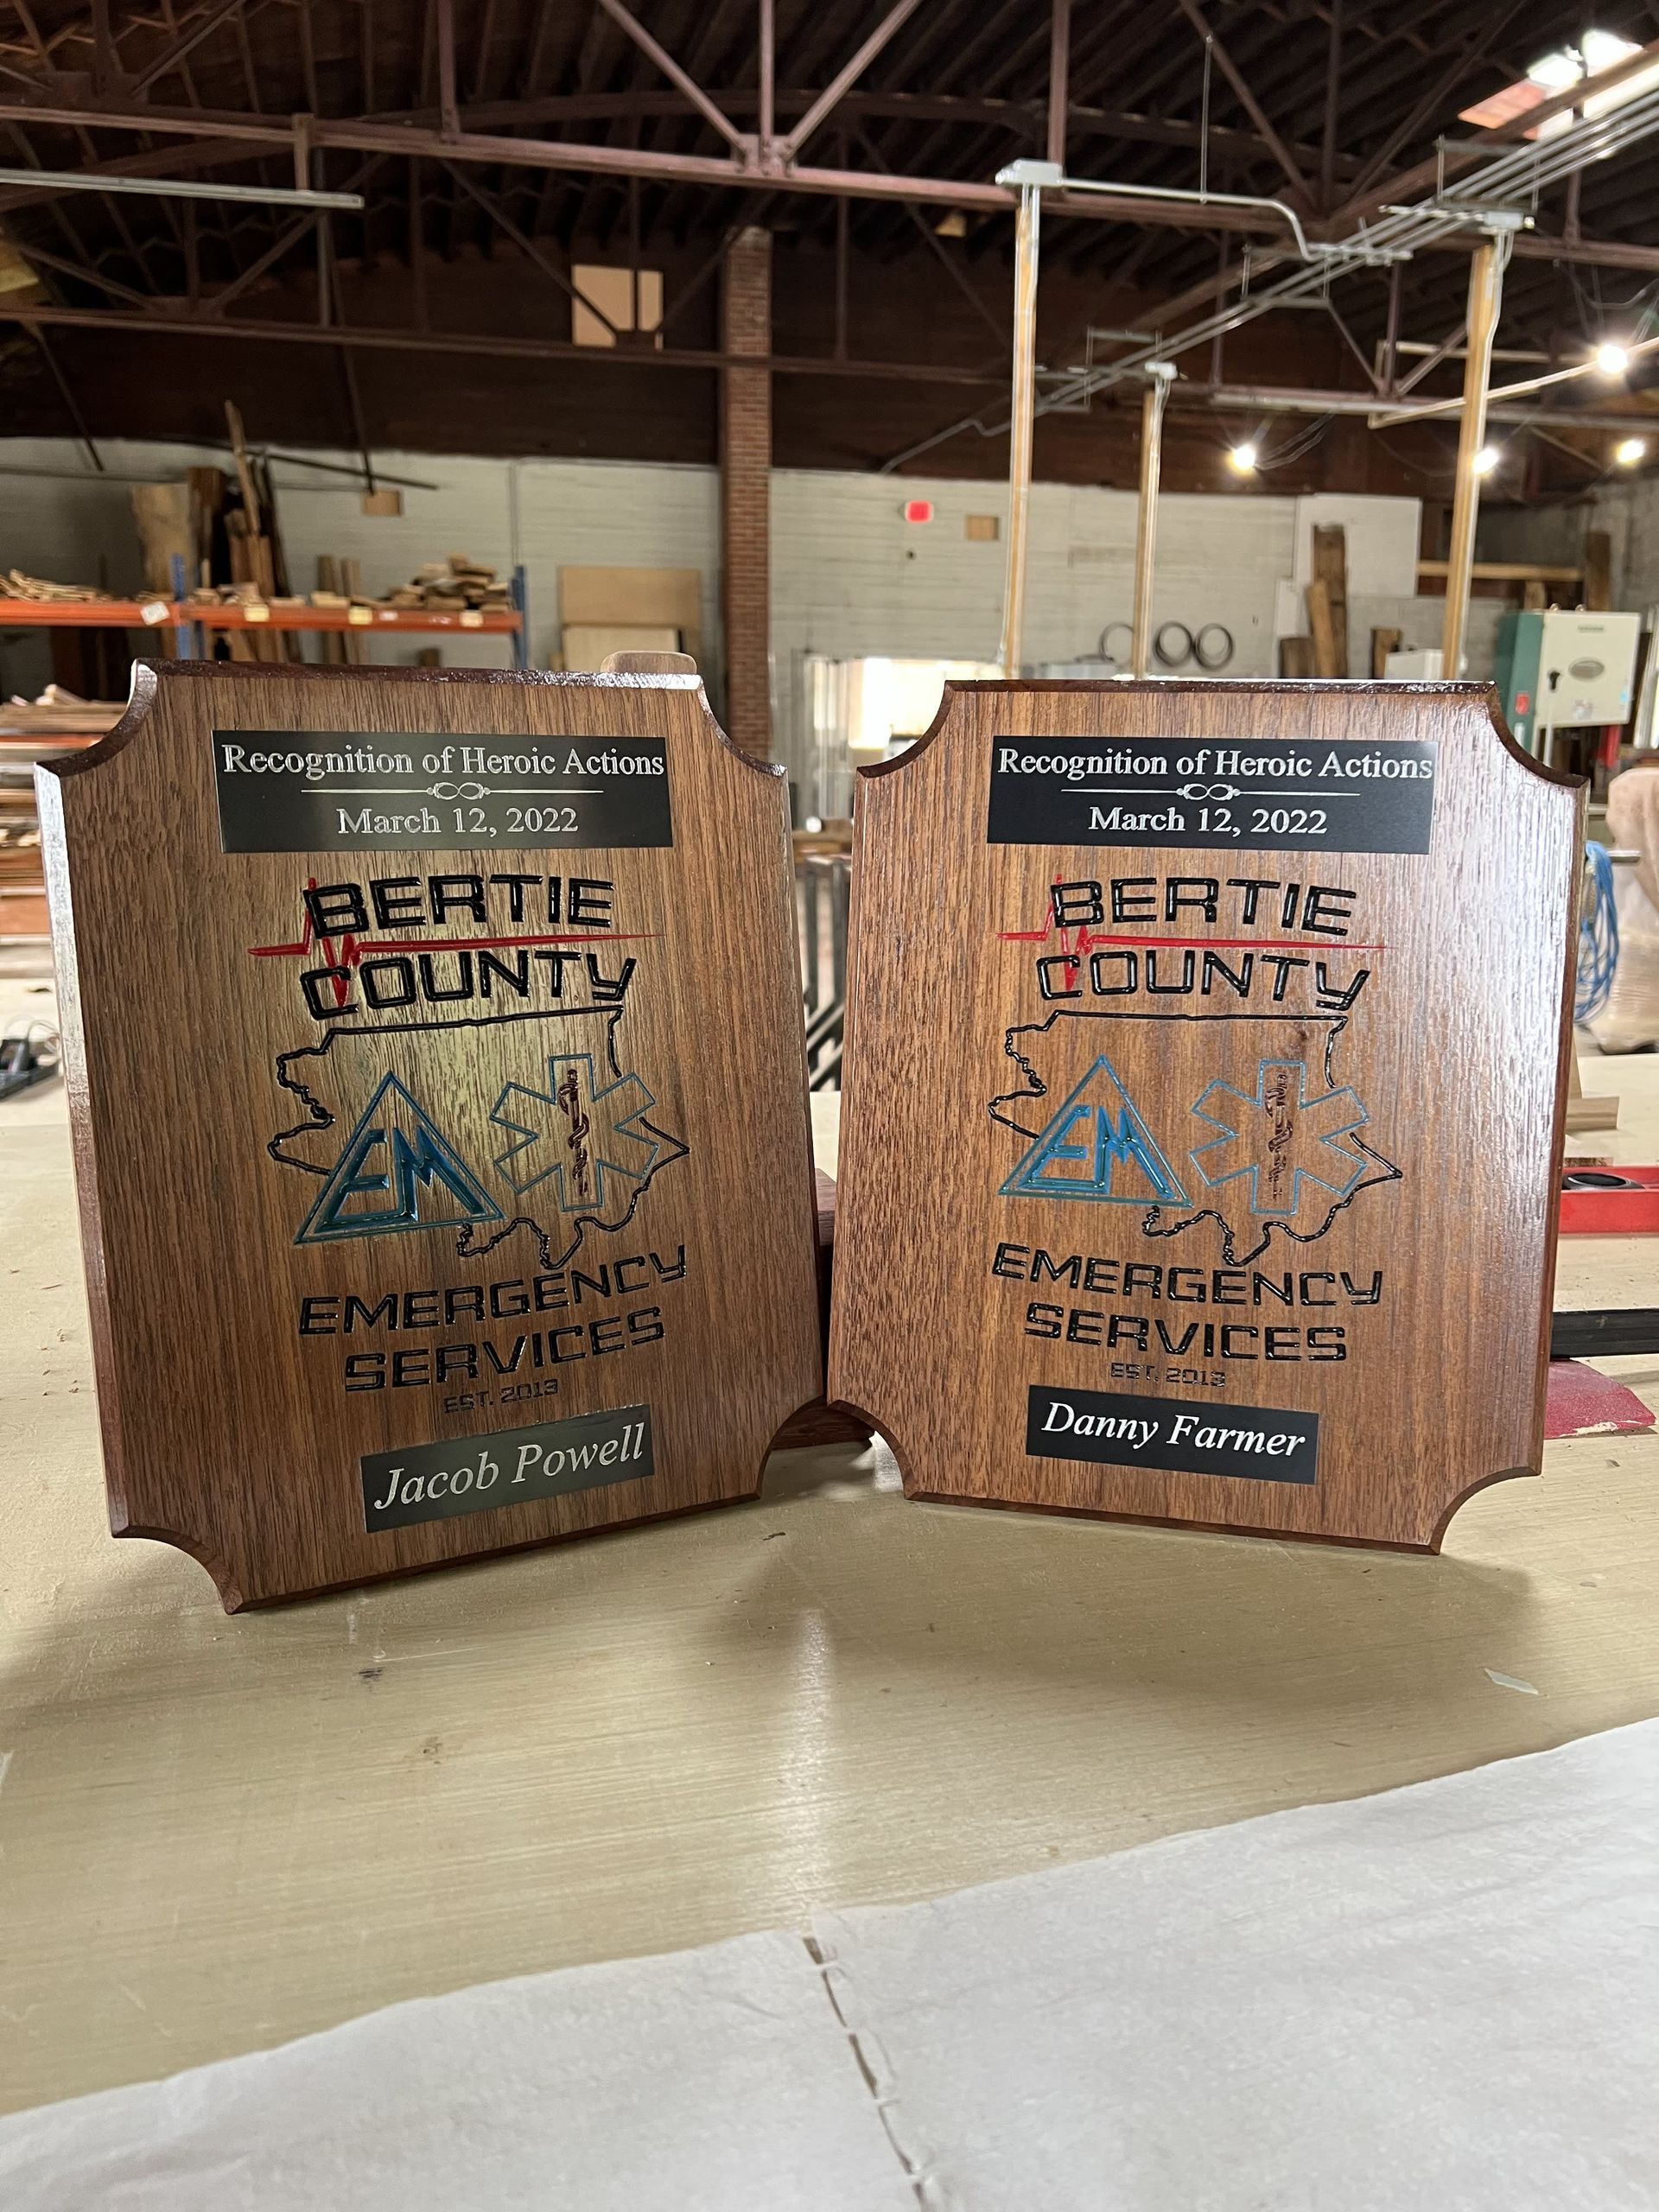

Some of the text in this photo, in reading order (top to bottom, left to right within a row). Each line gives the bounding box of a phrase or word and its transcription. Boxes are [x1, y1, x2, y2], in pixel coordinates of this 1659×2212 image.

[222, 743, 665, 780] Recognition of Heroic Actions
[998, 747, 1433, 781] Recognition of Heroic Actions
[337, 808, 579, 837] March 12, 2022
[1089, 806, 1328, 836] March 12, 2022
[304, 874, 615, 939] BERTIE
[1051, 877, 1357, 936] BERTIE
[301, 950, 637, 1020] COUNTY
[1036, 950, 1370, 1010] COUNTY
[299, 1245, 685, 1335] EMERGENCY
[992, 1243, 1382, 1306] EMERGENCY
[346, 1306, 665, 1391] SERVICES
[1025, 1303, 1348, 1361] SERVICES
[444, 1378, 559, 1414] EST. 2013
[1111, 1363, 1226, 1387] EST. 2013
[1042, 1402, 1306, 1457] Danny Farmer
[374, 1422, 645, 1510] Jacob Powell
